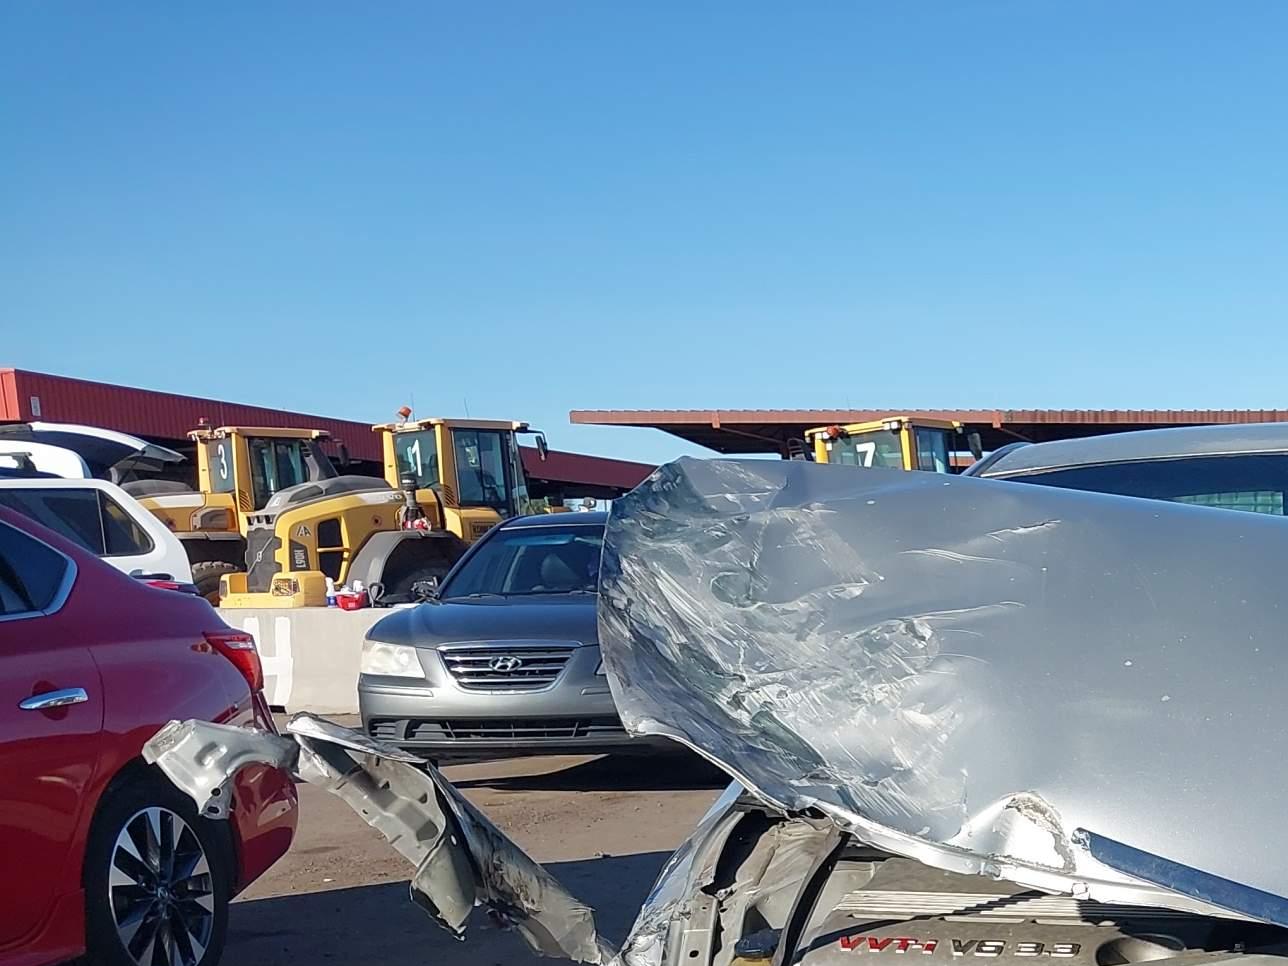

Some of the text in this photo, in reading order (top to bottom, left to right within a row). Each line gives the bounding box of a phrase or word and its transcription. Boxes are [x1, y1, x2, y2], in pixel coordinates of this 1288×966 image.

[217, 444, 228, 480] 3
[411, 439, 423, 477] 1
[856, 442, 876, 467] 7
[951, 938, 1006, 958] V6
[1014, 941, 1082, 958] 3.3
